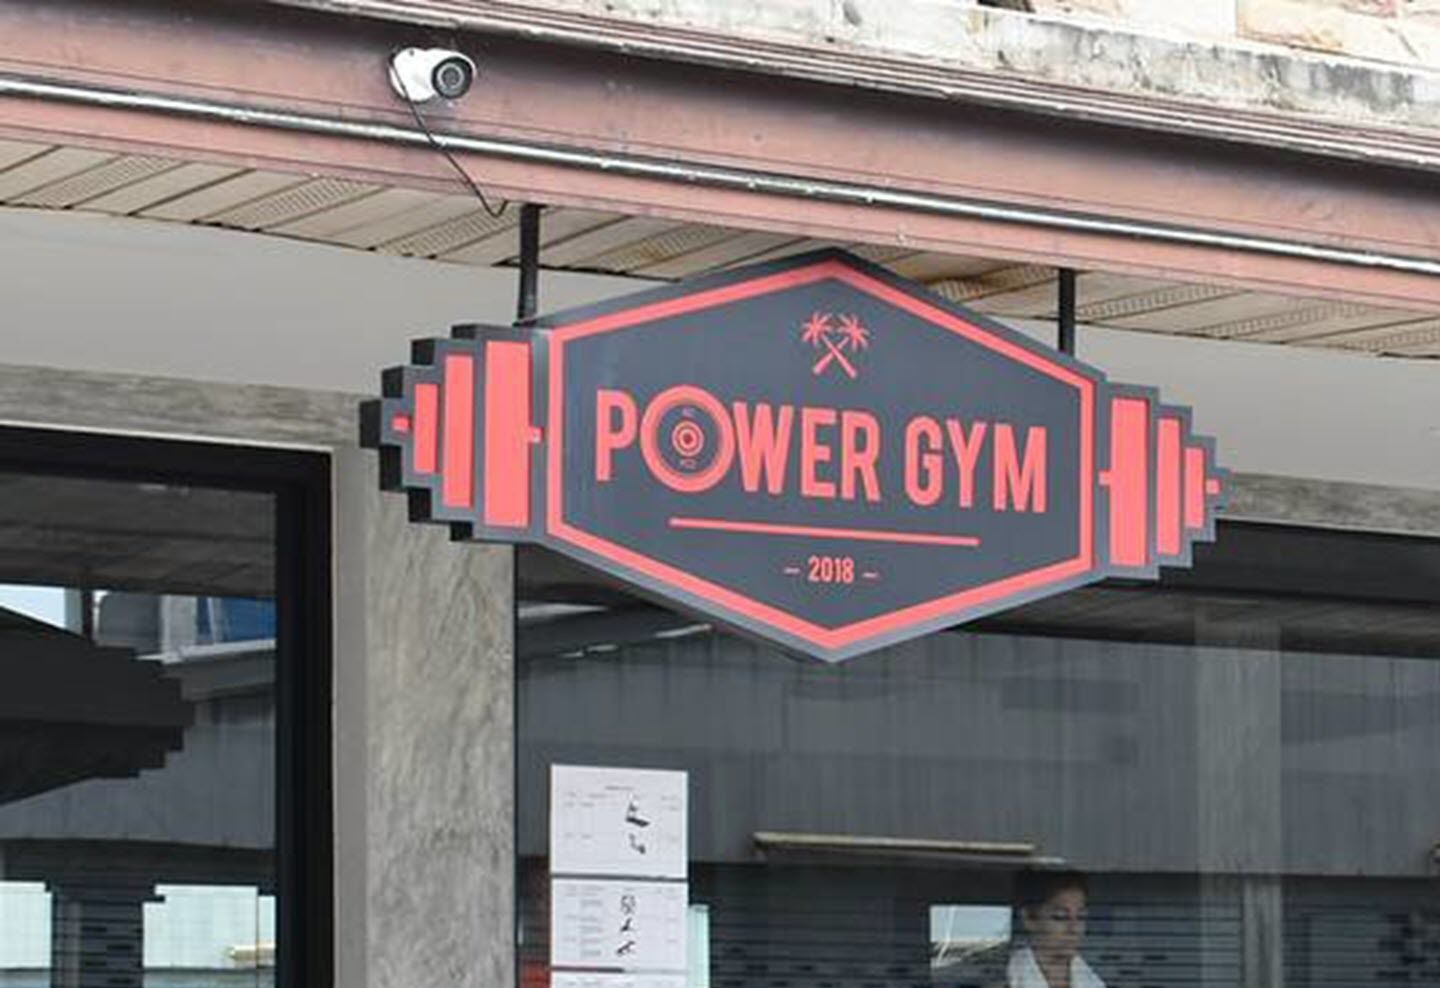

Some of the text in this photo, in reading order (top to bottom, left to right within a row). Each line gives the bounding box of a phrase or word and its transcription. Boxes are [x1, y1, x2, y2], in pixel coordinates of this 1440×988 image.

[596, 385, 1048, 513] POWER GYM
[808, 555, 854, 583] 2018
